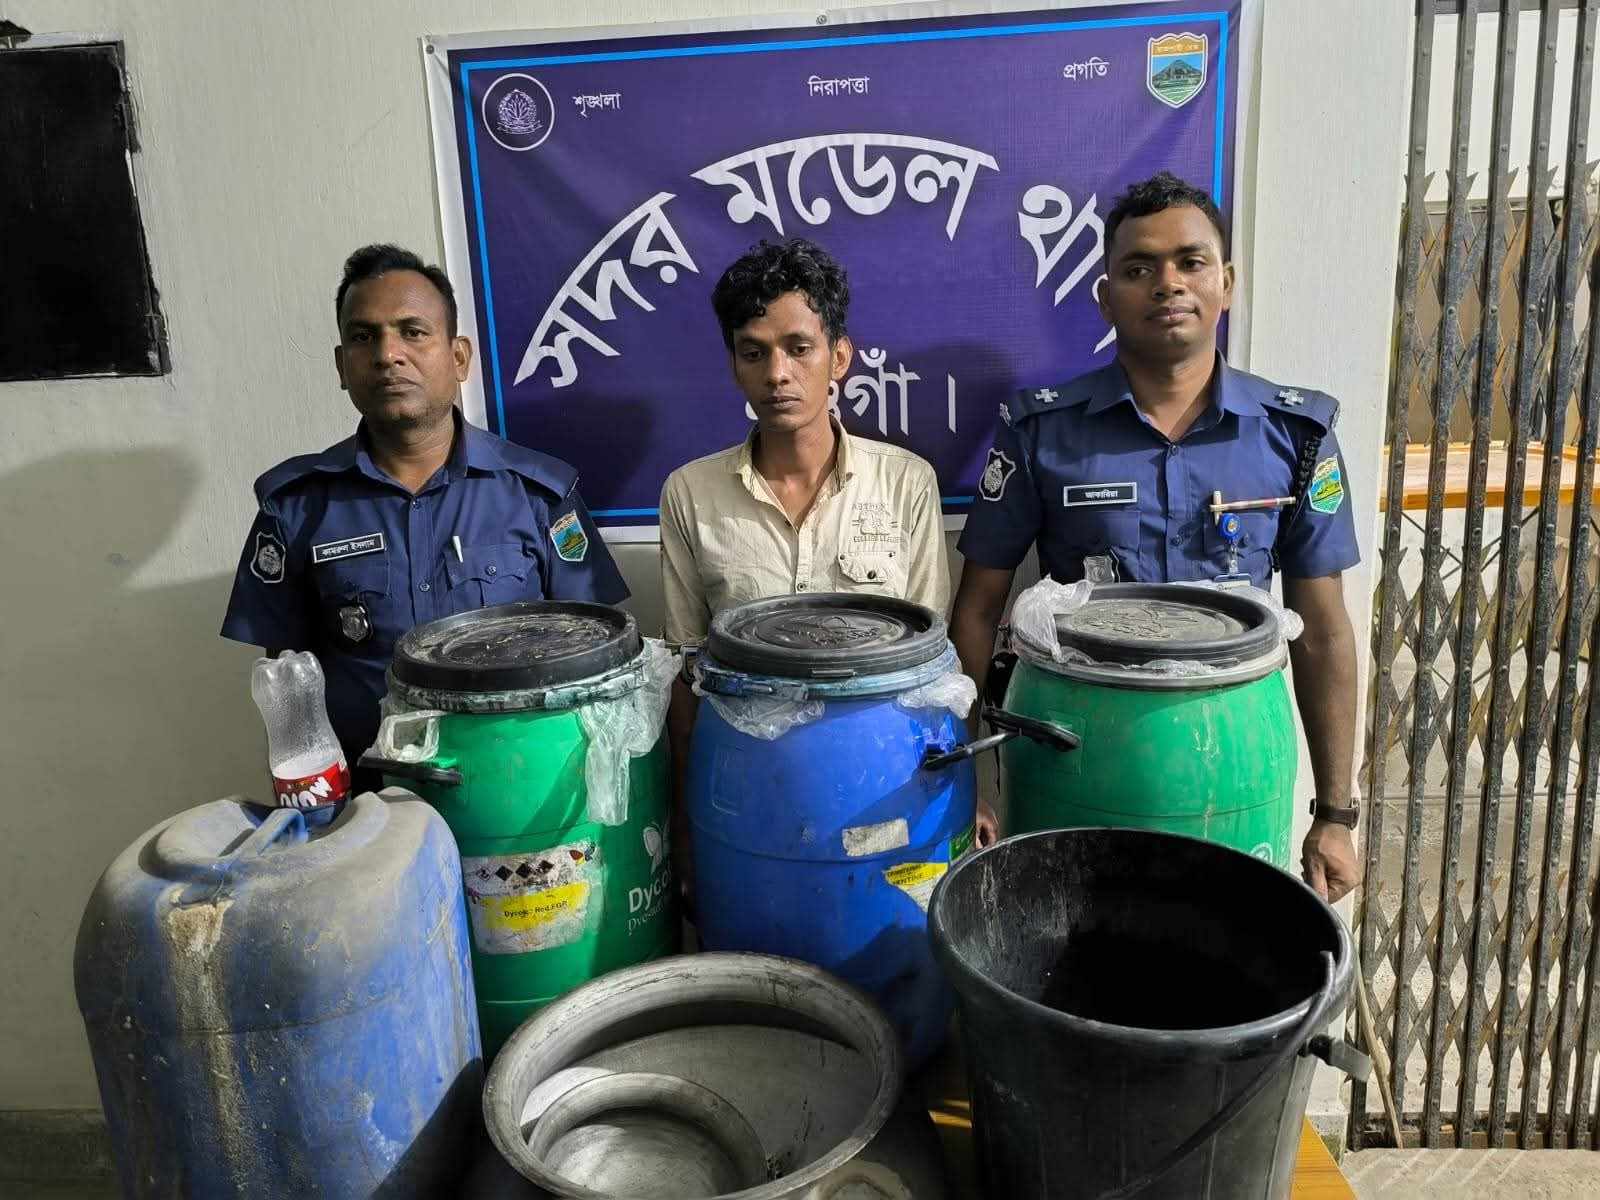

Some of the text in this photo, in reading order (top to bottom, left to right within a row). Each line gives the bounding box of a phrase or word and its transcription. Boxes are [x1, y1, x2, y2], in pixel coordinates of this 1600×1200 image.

[1063, 56, 1110, 80] প্রগতি
[808, 75, 870, 97] নিরাপত্তা
[513, 191, 699, 387] সদর
[691, 133, 1000, 241] মডেল
